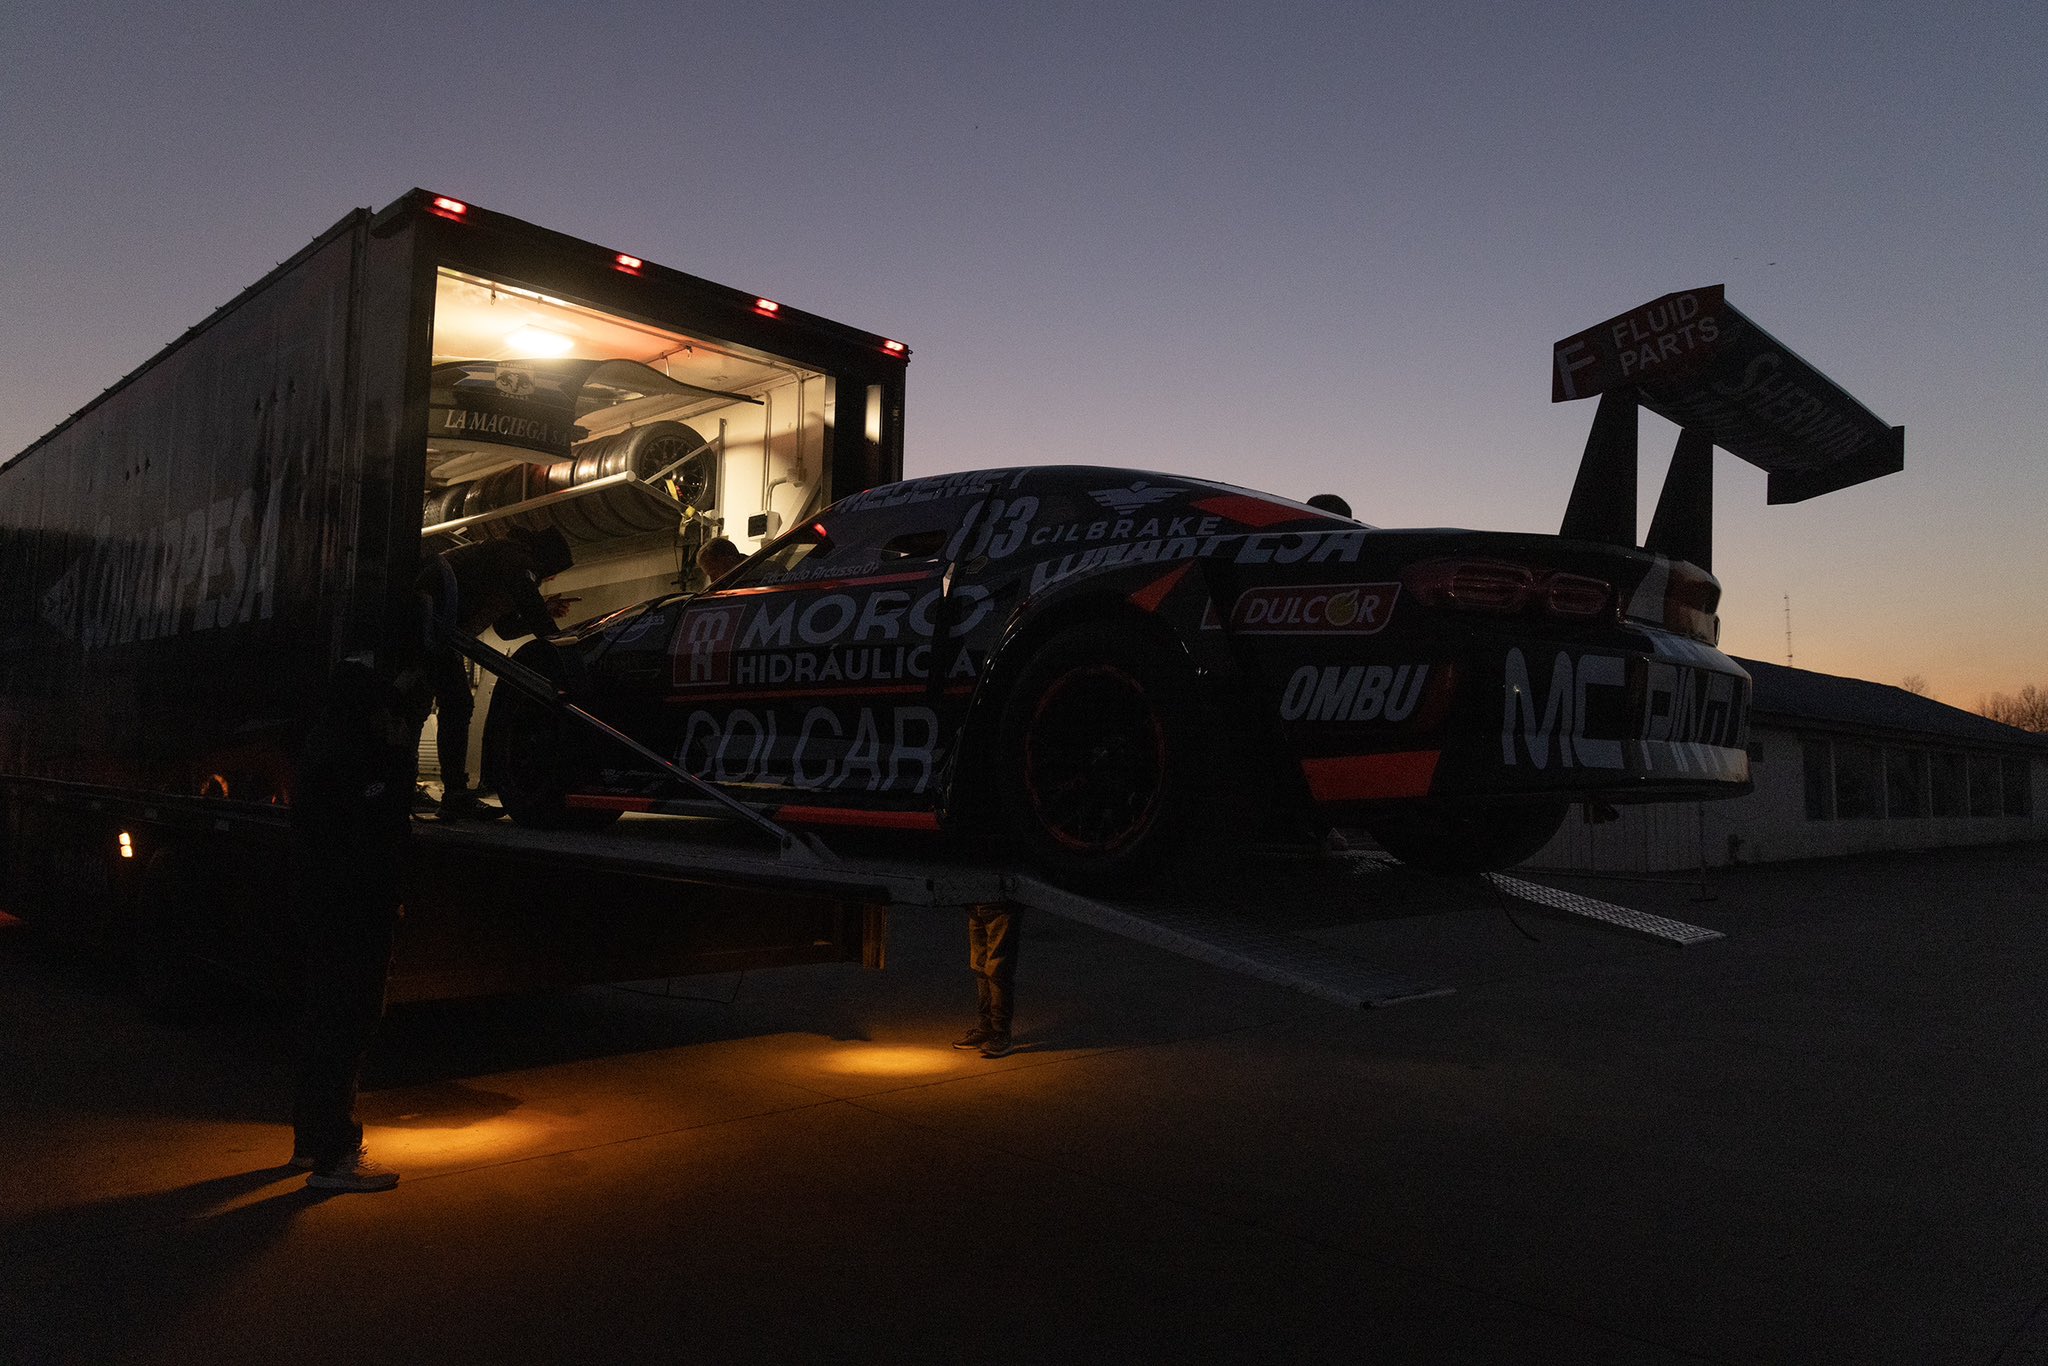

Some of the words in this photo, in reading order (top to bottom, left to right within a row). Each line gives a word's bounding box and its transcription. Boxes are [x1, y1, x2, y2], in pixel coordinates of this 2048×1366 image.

[1611, 293, 1700, 349] FLUID
[1619, 316, 1720, 377] PARTS
[444, 408, 467, 429] LA
[468, 411, 548, 443] MACIEGA
[1031, 516, 1223, 546] CILBRAKE
[741, 584, 995, 649] MORO
[1245, 588, 1382, 627] DULCOR
[736, 642, 978, 686] HIDRÁULICA
[1279, 664, 1430, 722] OMBU
[1501, 646, 1626, 771] MC
[677, 704, 940, 795] COLCAR
